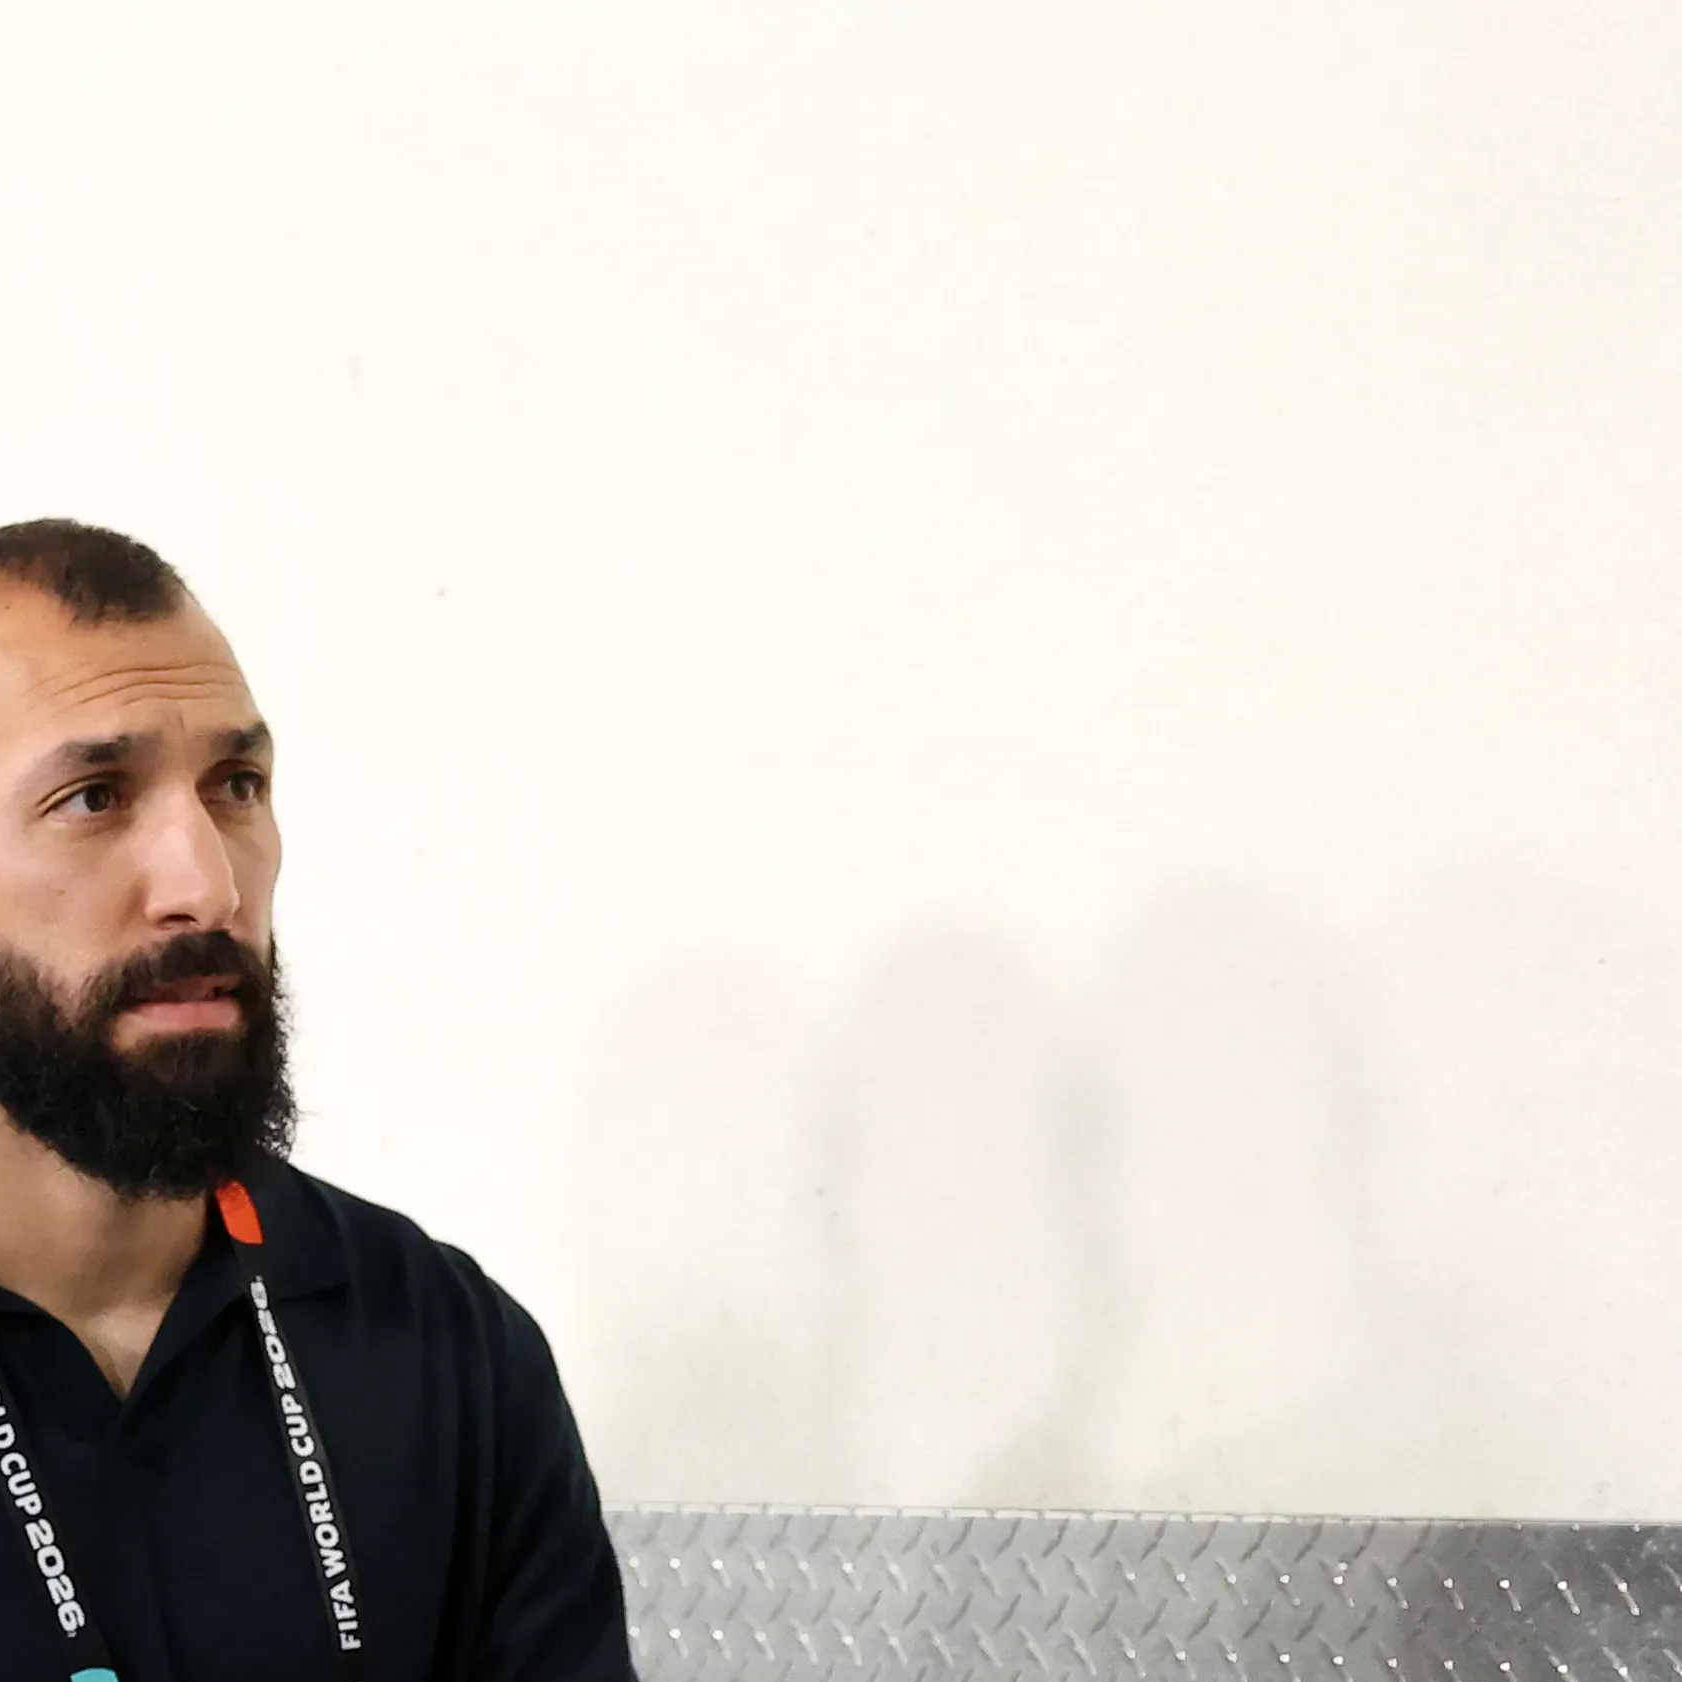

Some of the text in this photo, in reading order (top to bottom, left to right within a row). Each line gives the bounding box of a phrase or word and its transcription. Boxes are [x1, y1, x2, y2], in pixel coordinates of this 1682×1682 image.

[281, 1393, 315, 1457] CUP
[0, 1452, 42, 1516] CUP
[24, 1518, 85, 1632] 2026
[299, 1460, 347, 1578] WORLD
[329, 1579, 362, 1650] FIFA
